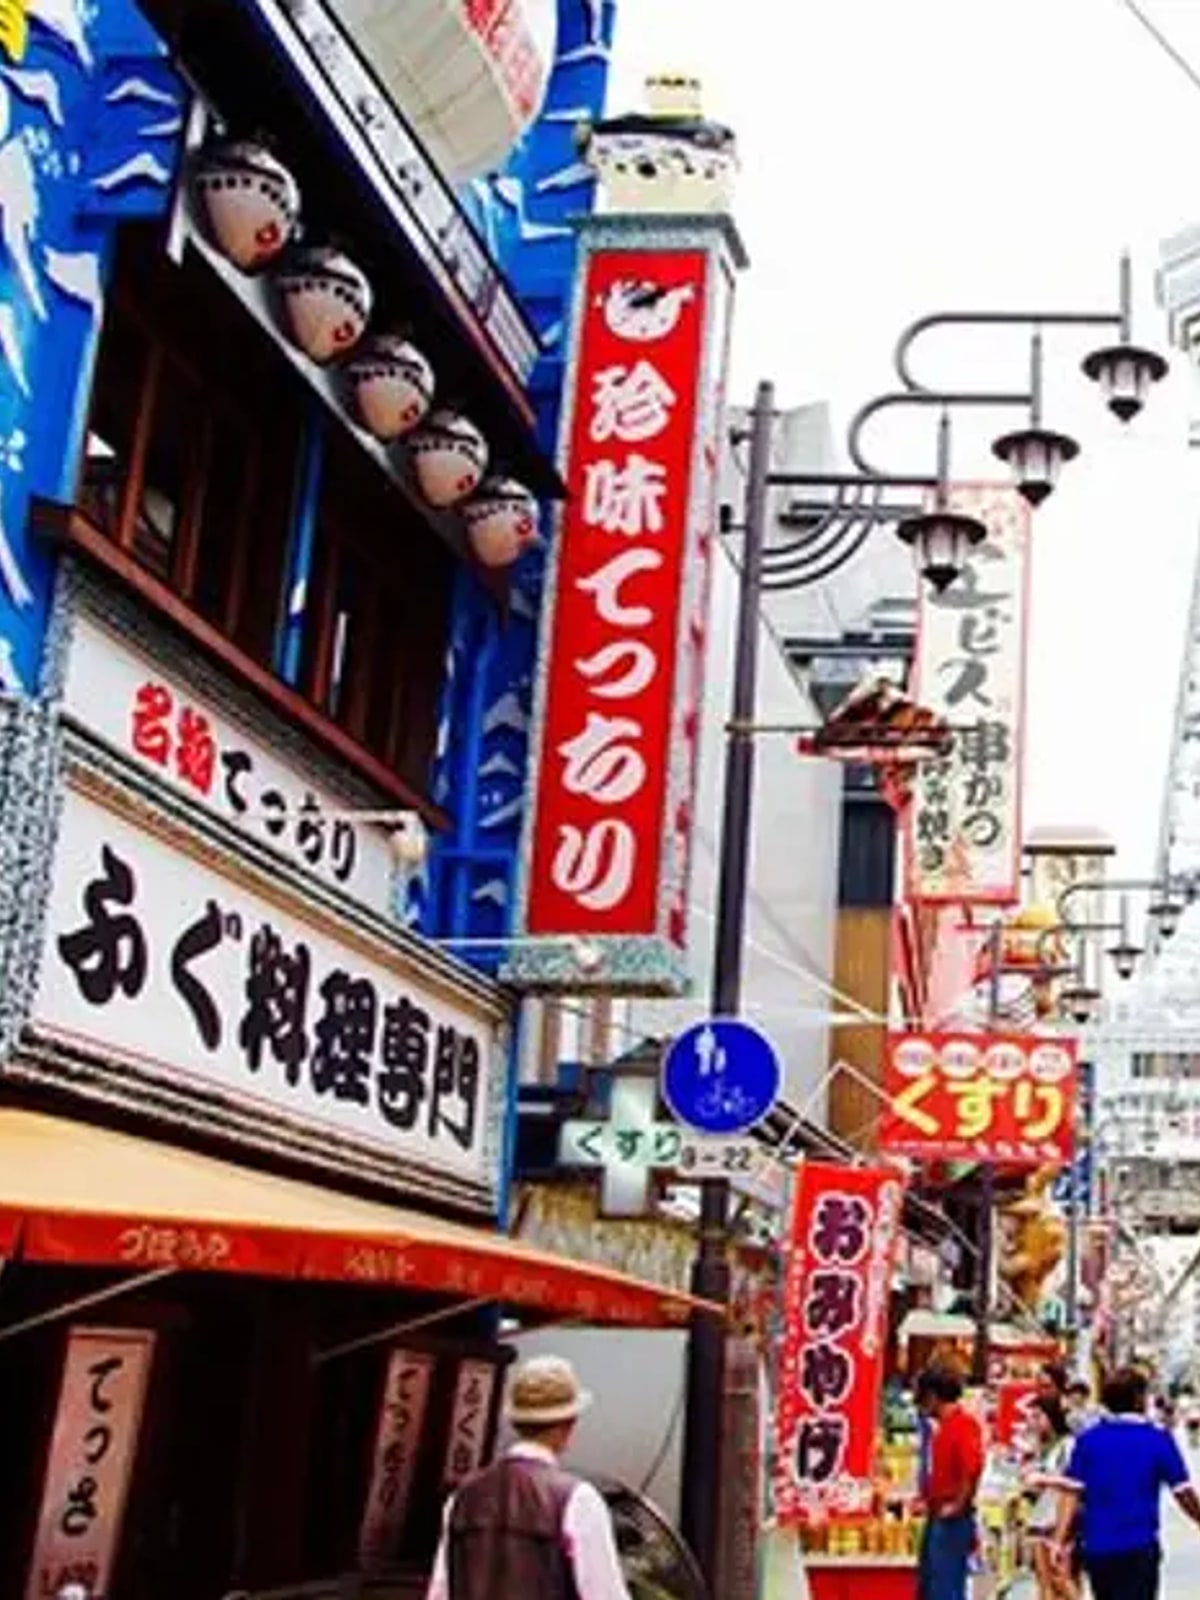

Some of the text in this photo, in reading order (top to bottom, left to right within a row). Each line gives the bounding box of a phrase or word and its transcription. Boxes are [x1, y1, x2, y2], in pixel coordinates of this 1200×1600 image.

[58, 844, 482, 1150] ふぐ料理専門
[892, 1073, 1063, 1139] くすり
[576, 1129, 682, 1162] くすり
